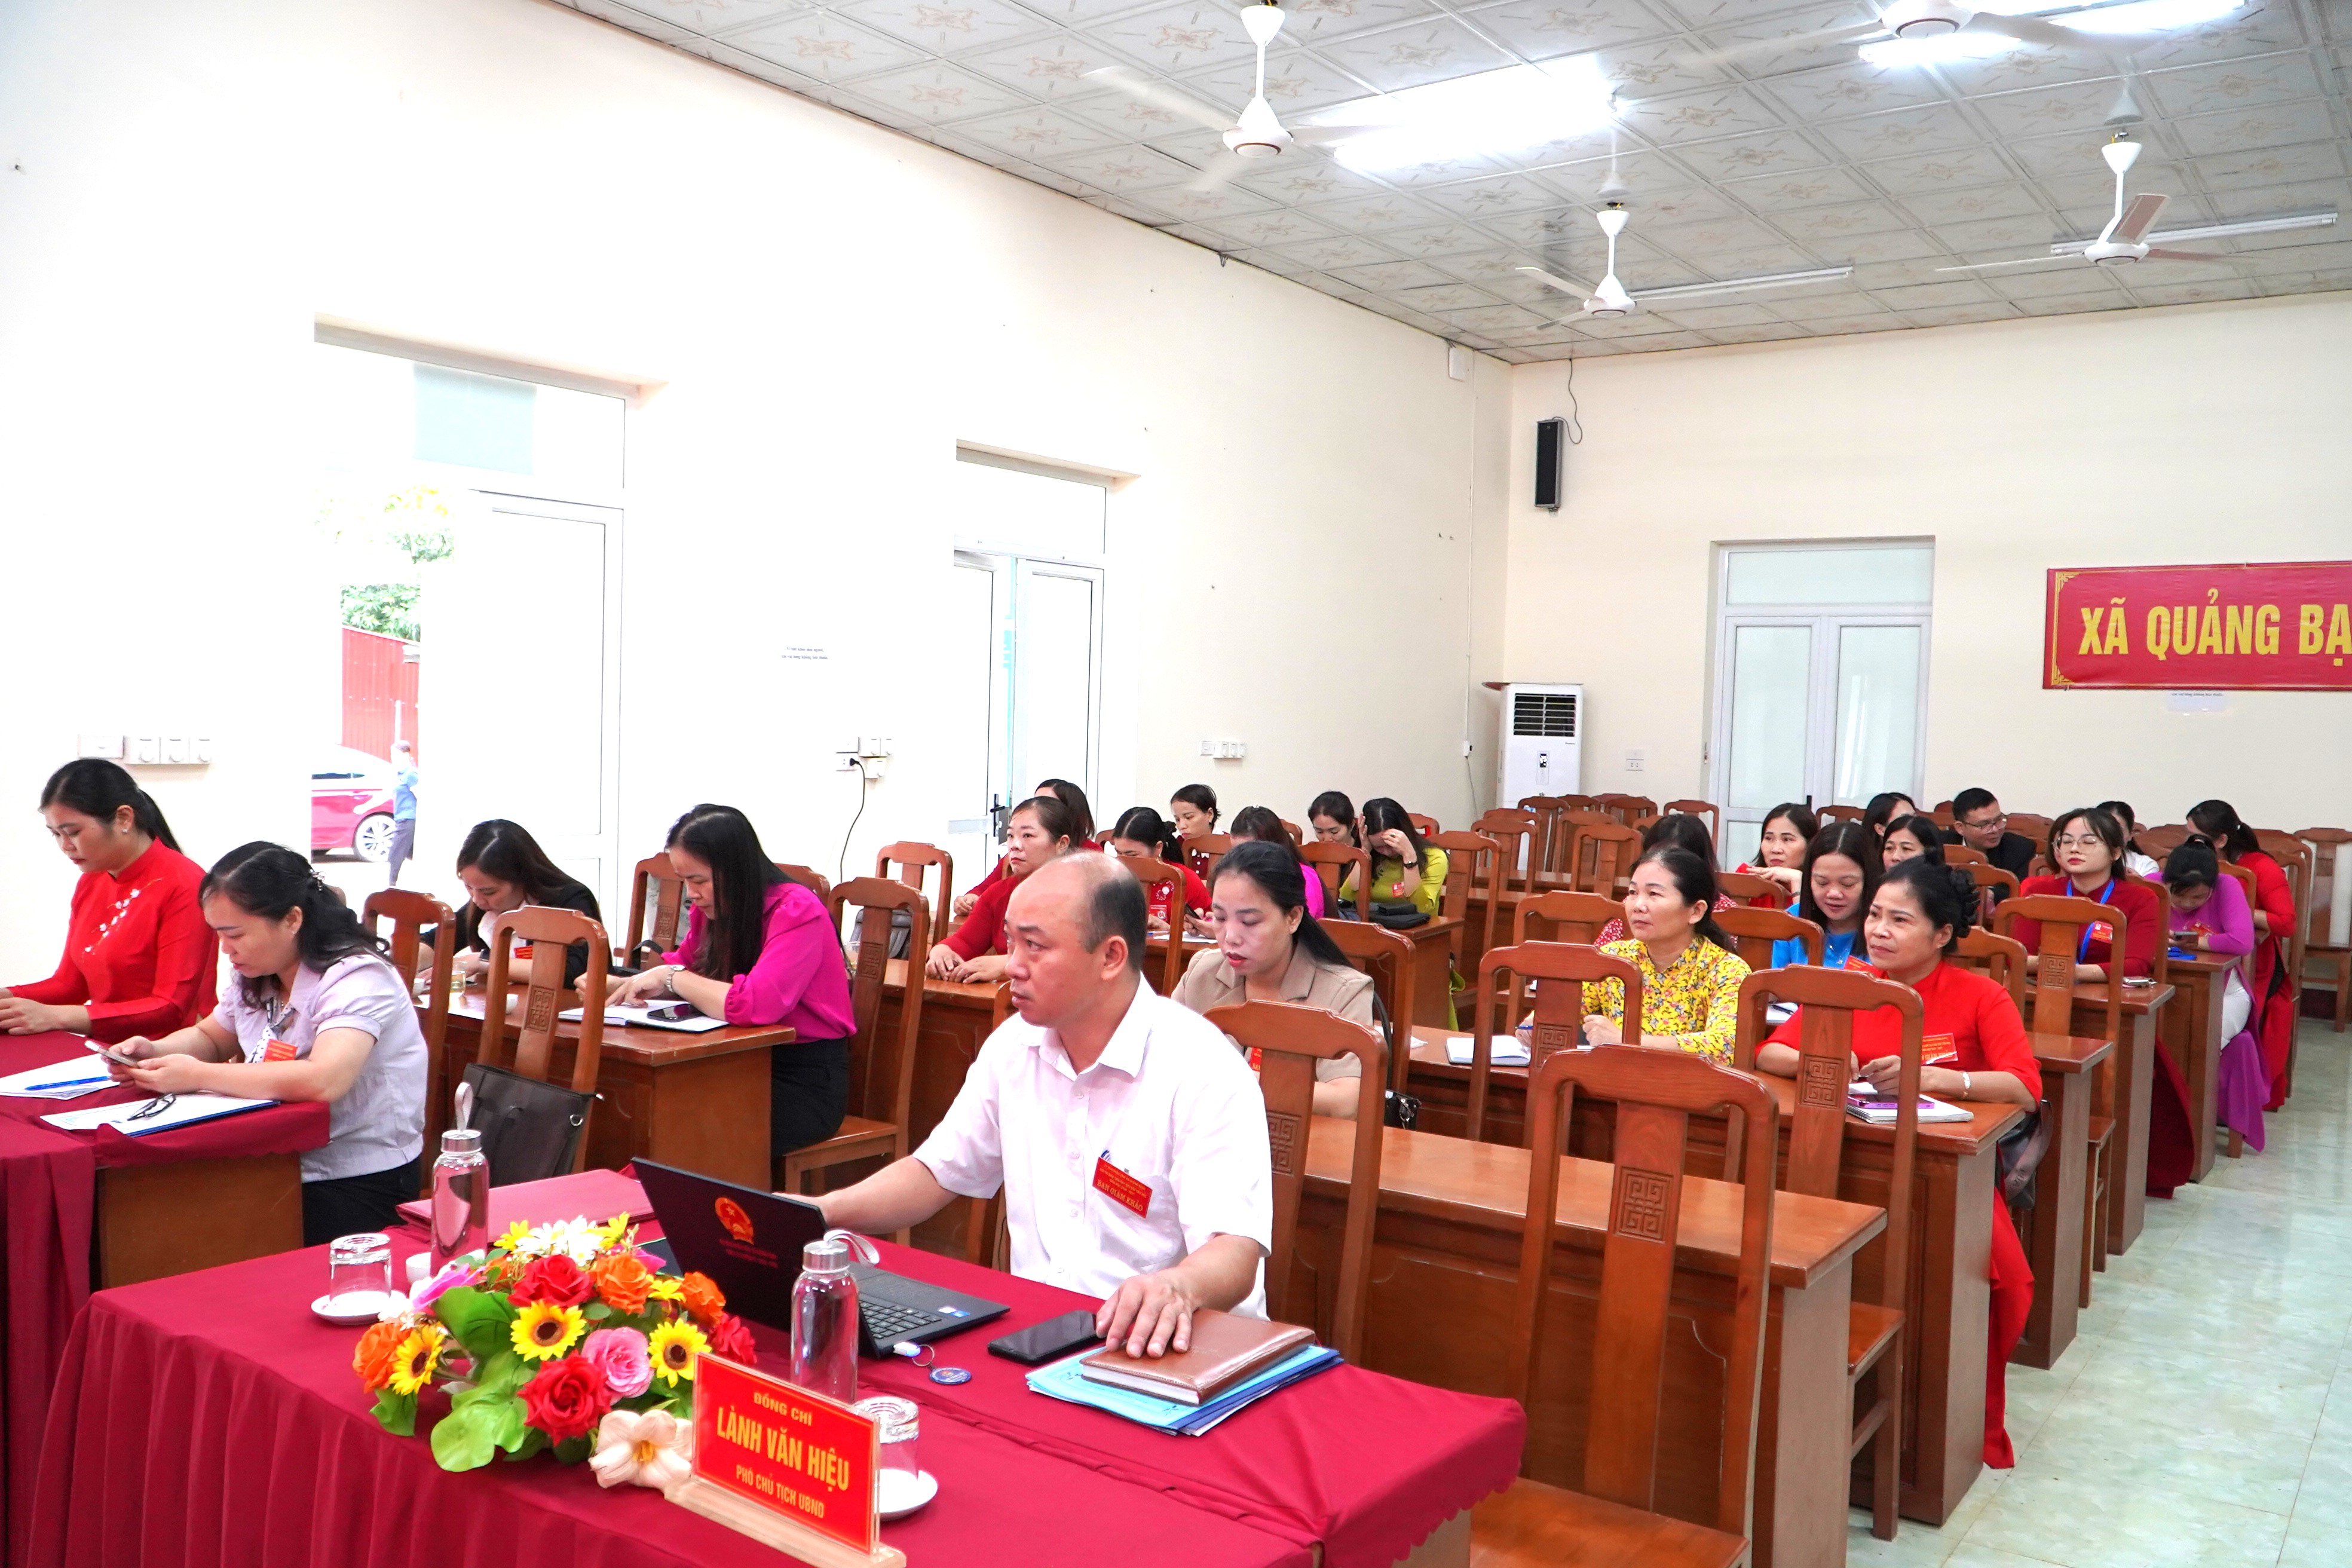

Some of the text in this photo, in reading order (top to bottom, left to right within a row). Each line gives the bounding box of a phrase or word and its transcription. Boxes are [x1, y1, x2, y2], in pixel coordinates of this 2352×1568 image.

[2078, 589, 2352, 666] XÃ QUẢNG BẠ
[1097, 1180, 1143, 1212] BAN GIÁM KHẢO
[717, 1405, 849, 1492] LÀNH VĂN HIỆU
[736, 1465, 824, 1518] PHÓ CHỦ TỊCH UBND
